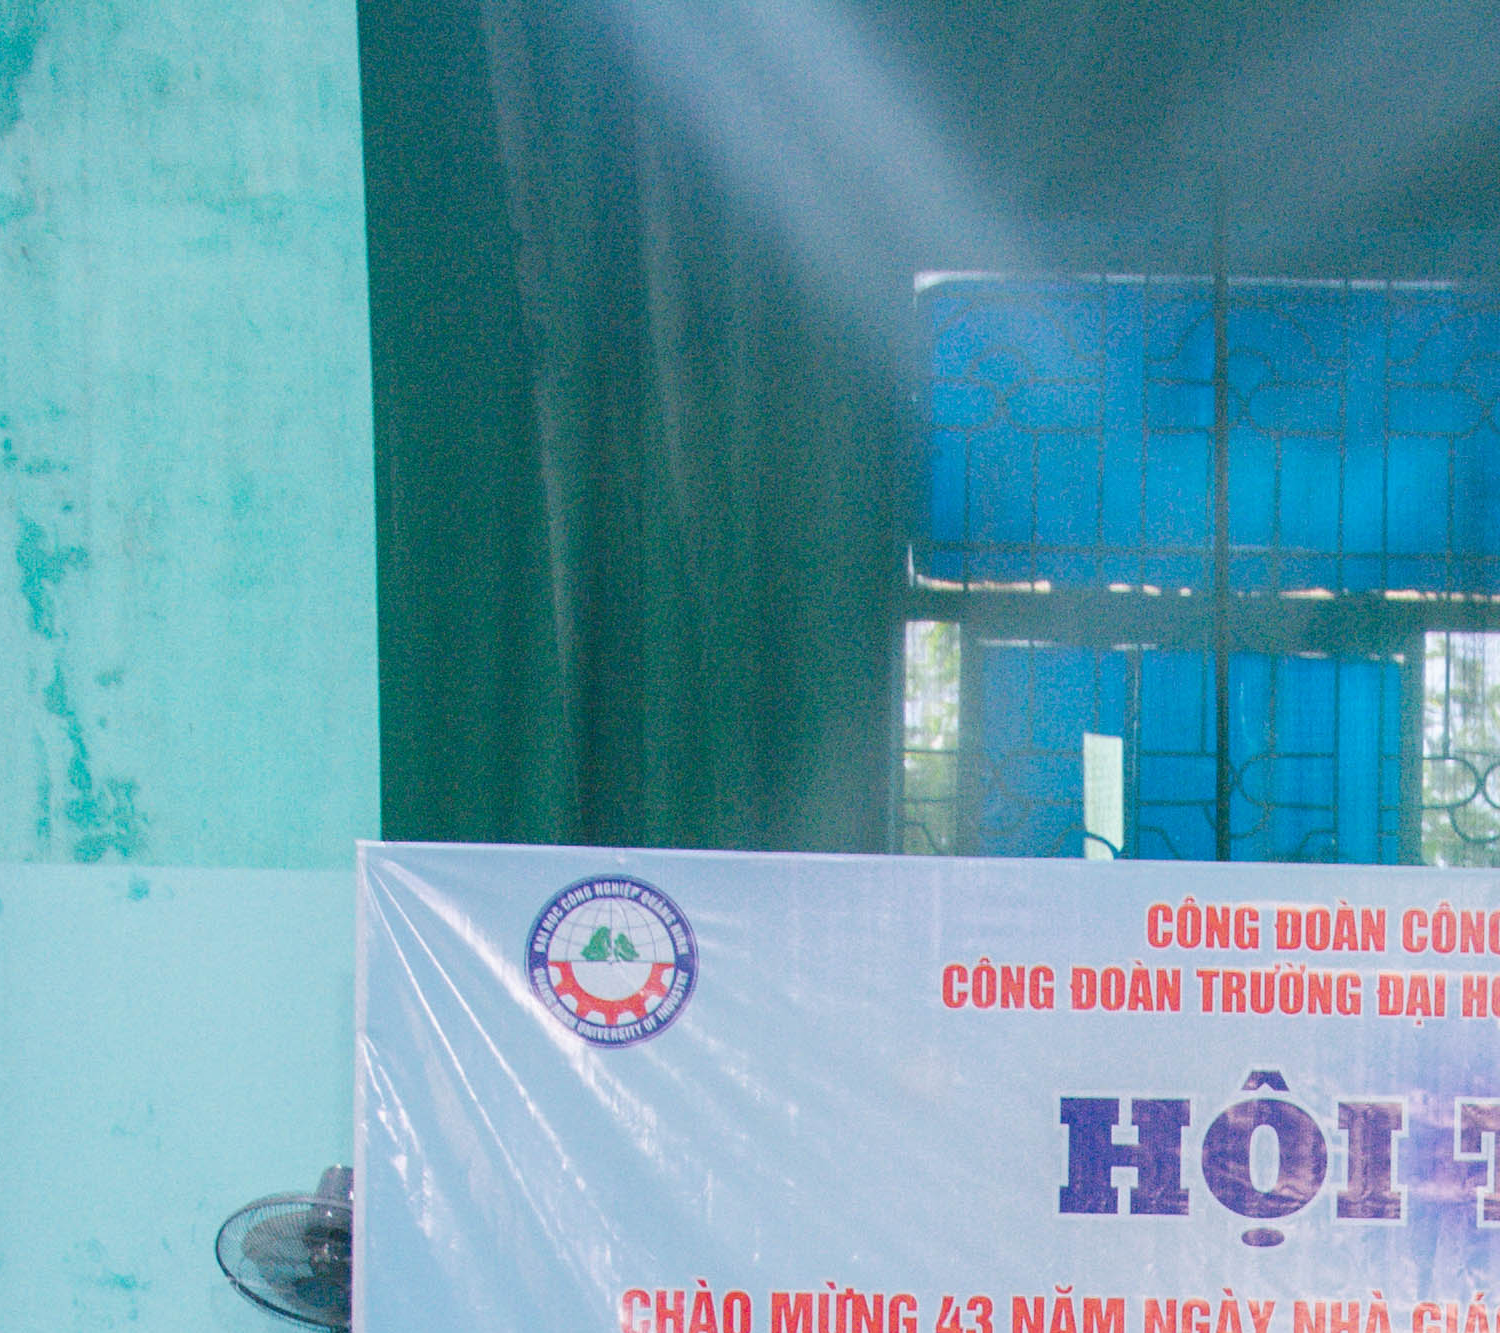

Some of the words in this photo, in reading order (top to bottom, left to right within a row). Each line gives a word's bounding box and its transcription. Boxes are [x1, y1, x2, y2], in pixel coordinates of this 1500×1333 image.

[1147, 896, 1260, 950] CÔNG
[1275, 899, 1387, 953] ĐOÀN
[942, 956, 1055, 1010] CÔNG
[1069, 960, 1181, 1012] ĐOÀN
[1196, 963, 1362, 1016] TRƯỜNG
[1377, 973, 1446, 1026] ĐẠI
[1059, 1070, 1405, 1248] HỘI
